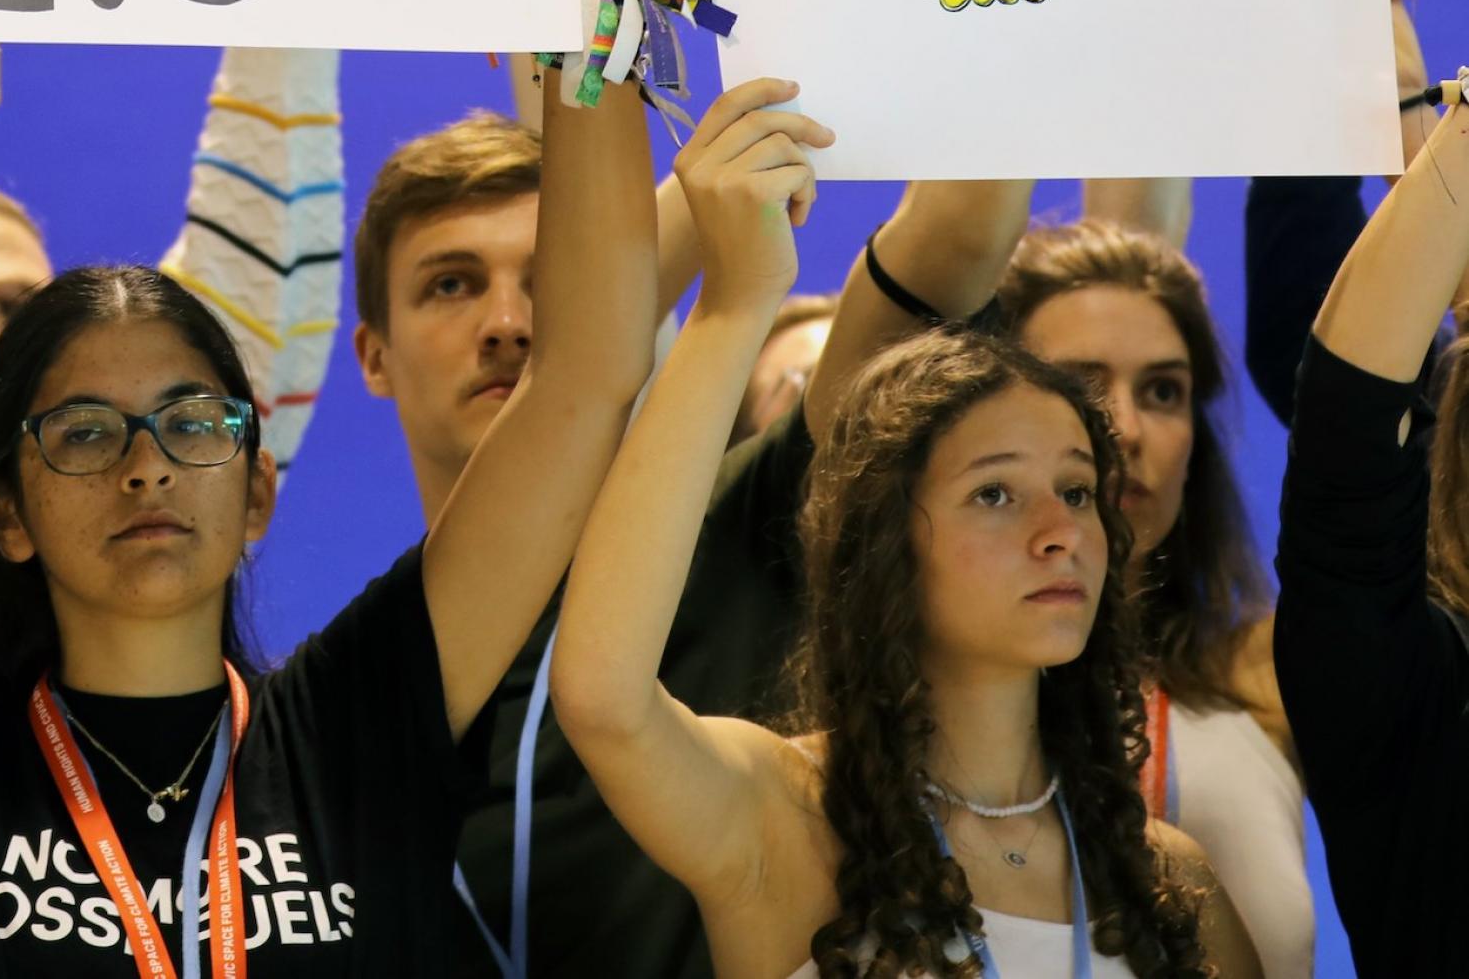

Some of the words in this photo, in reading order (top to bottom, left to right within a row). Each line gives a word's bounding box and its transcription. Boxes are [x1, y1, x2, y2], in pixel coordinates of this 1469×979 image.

[46, 723, 61, 745] AND
[53, 743, 76, 779] RIGHTS
[69, 775, 93, 814] HUMAN
[97, 839, 123, 875] ACTION
[217, 820, 228, 858] ACTION
[113, 875, 142, 916] CLIMATE
[218, 860, 232, 901] CLIMATE
[133, 913, 151, 937] FOR
[220, 901, 234, 926] FOR
[141, 937, 163, 974] SPACE
[221, 925, 236, 960] SPACE
